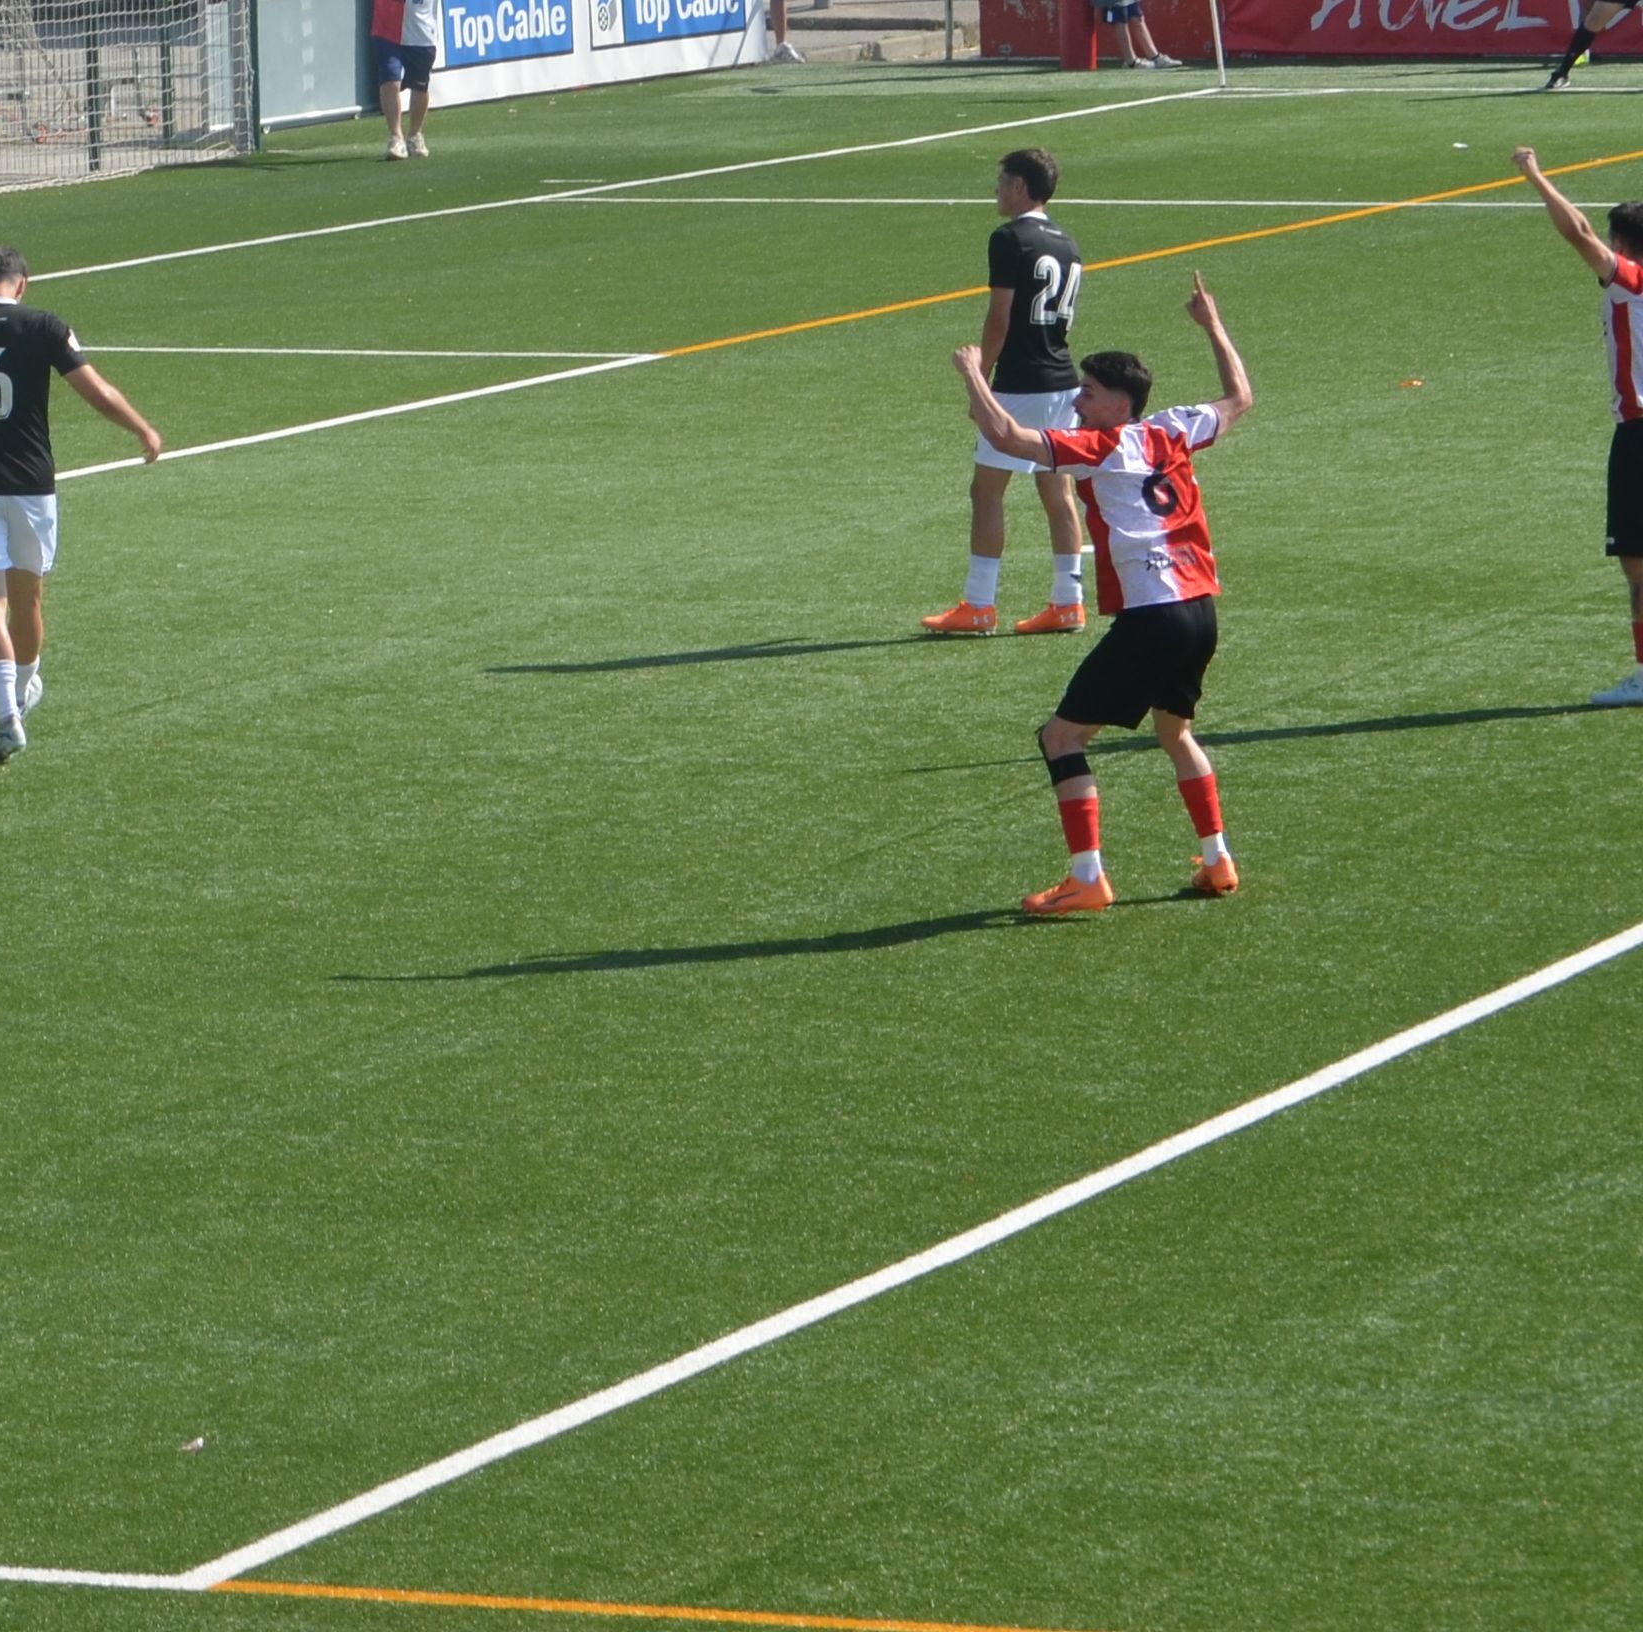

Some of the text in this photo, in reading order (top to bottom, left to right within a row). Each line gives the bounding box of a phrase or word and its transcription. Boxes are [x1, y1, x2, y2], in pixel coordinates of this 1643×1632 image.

[448, 7, 494, 57] Top
[1029, 254, 1083, 331] 24
[1141, 460, 1179, 517] 6
